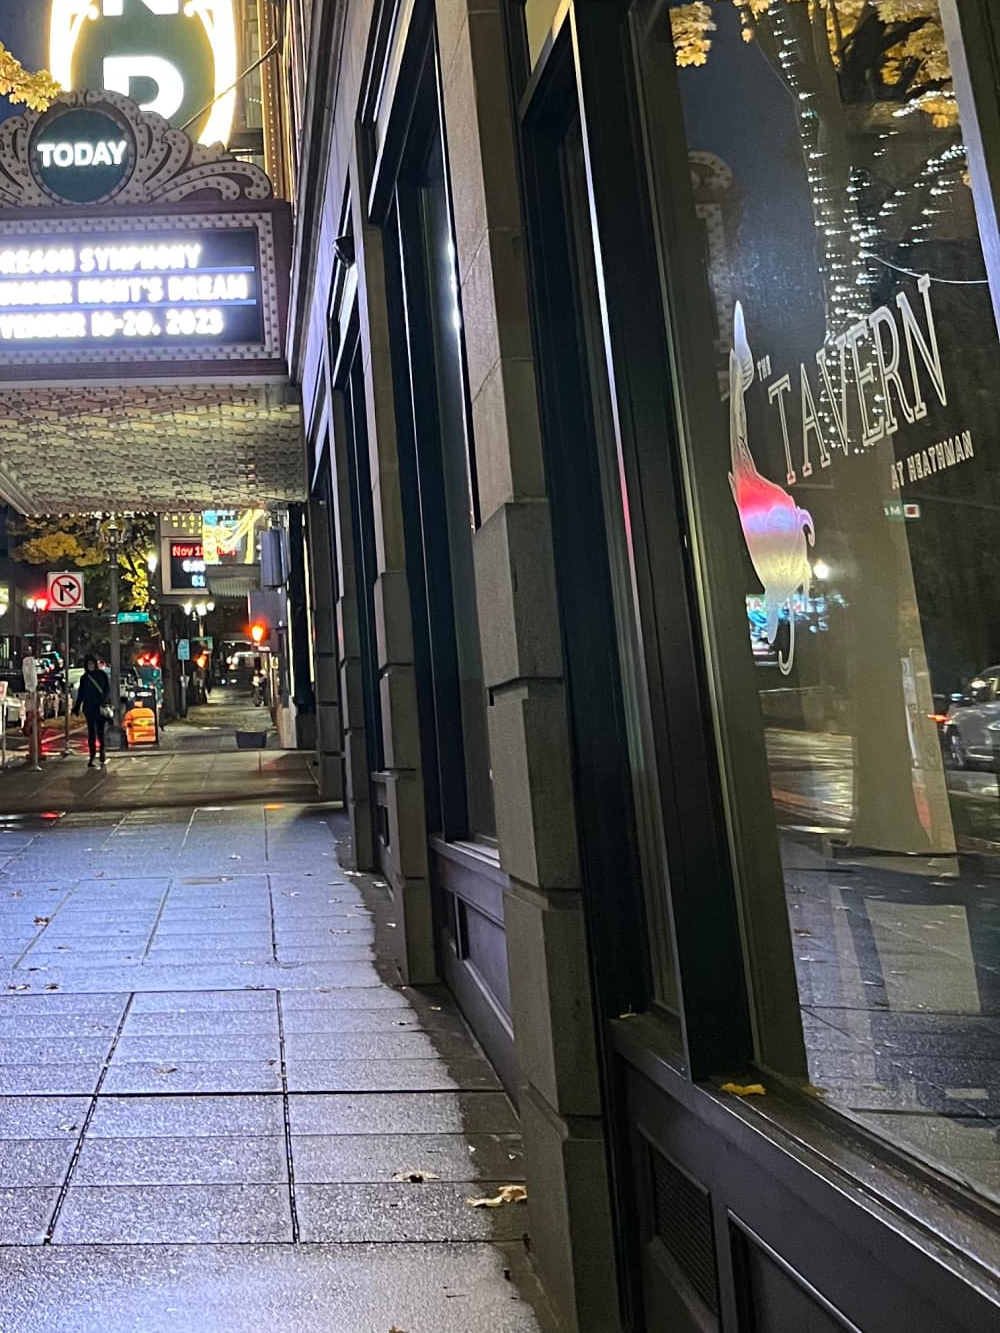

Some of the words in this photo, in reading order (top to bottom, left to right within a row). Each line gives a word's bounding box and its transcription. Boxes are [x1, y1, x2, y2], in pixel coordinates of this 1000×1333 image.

[37, 140, 128, 168] TODAY
[79, 243, 202, 272] SYMPHONY
[77, 276, 164, 304] NIGHT'S
[167, 273, 248, 301] DREAM
[165, 307, 225, 336] 2023
[757, 353, 772, 382] THE
[767, 274, 948, 486] TAVERN
[891, 460, 904, 491] AT
[906, 430, 975, 483] HEATHMAN
[172, 546, 193, 556] Nov
